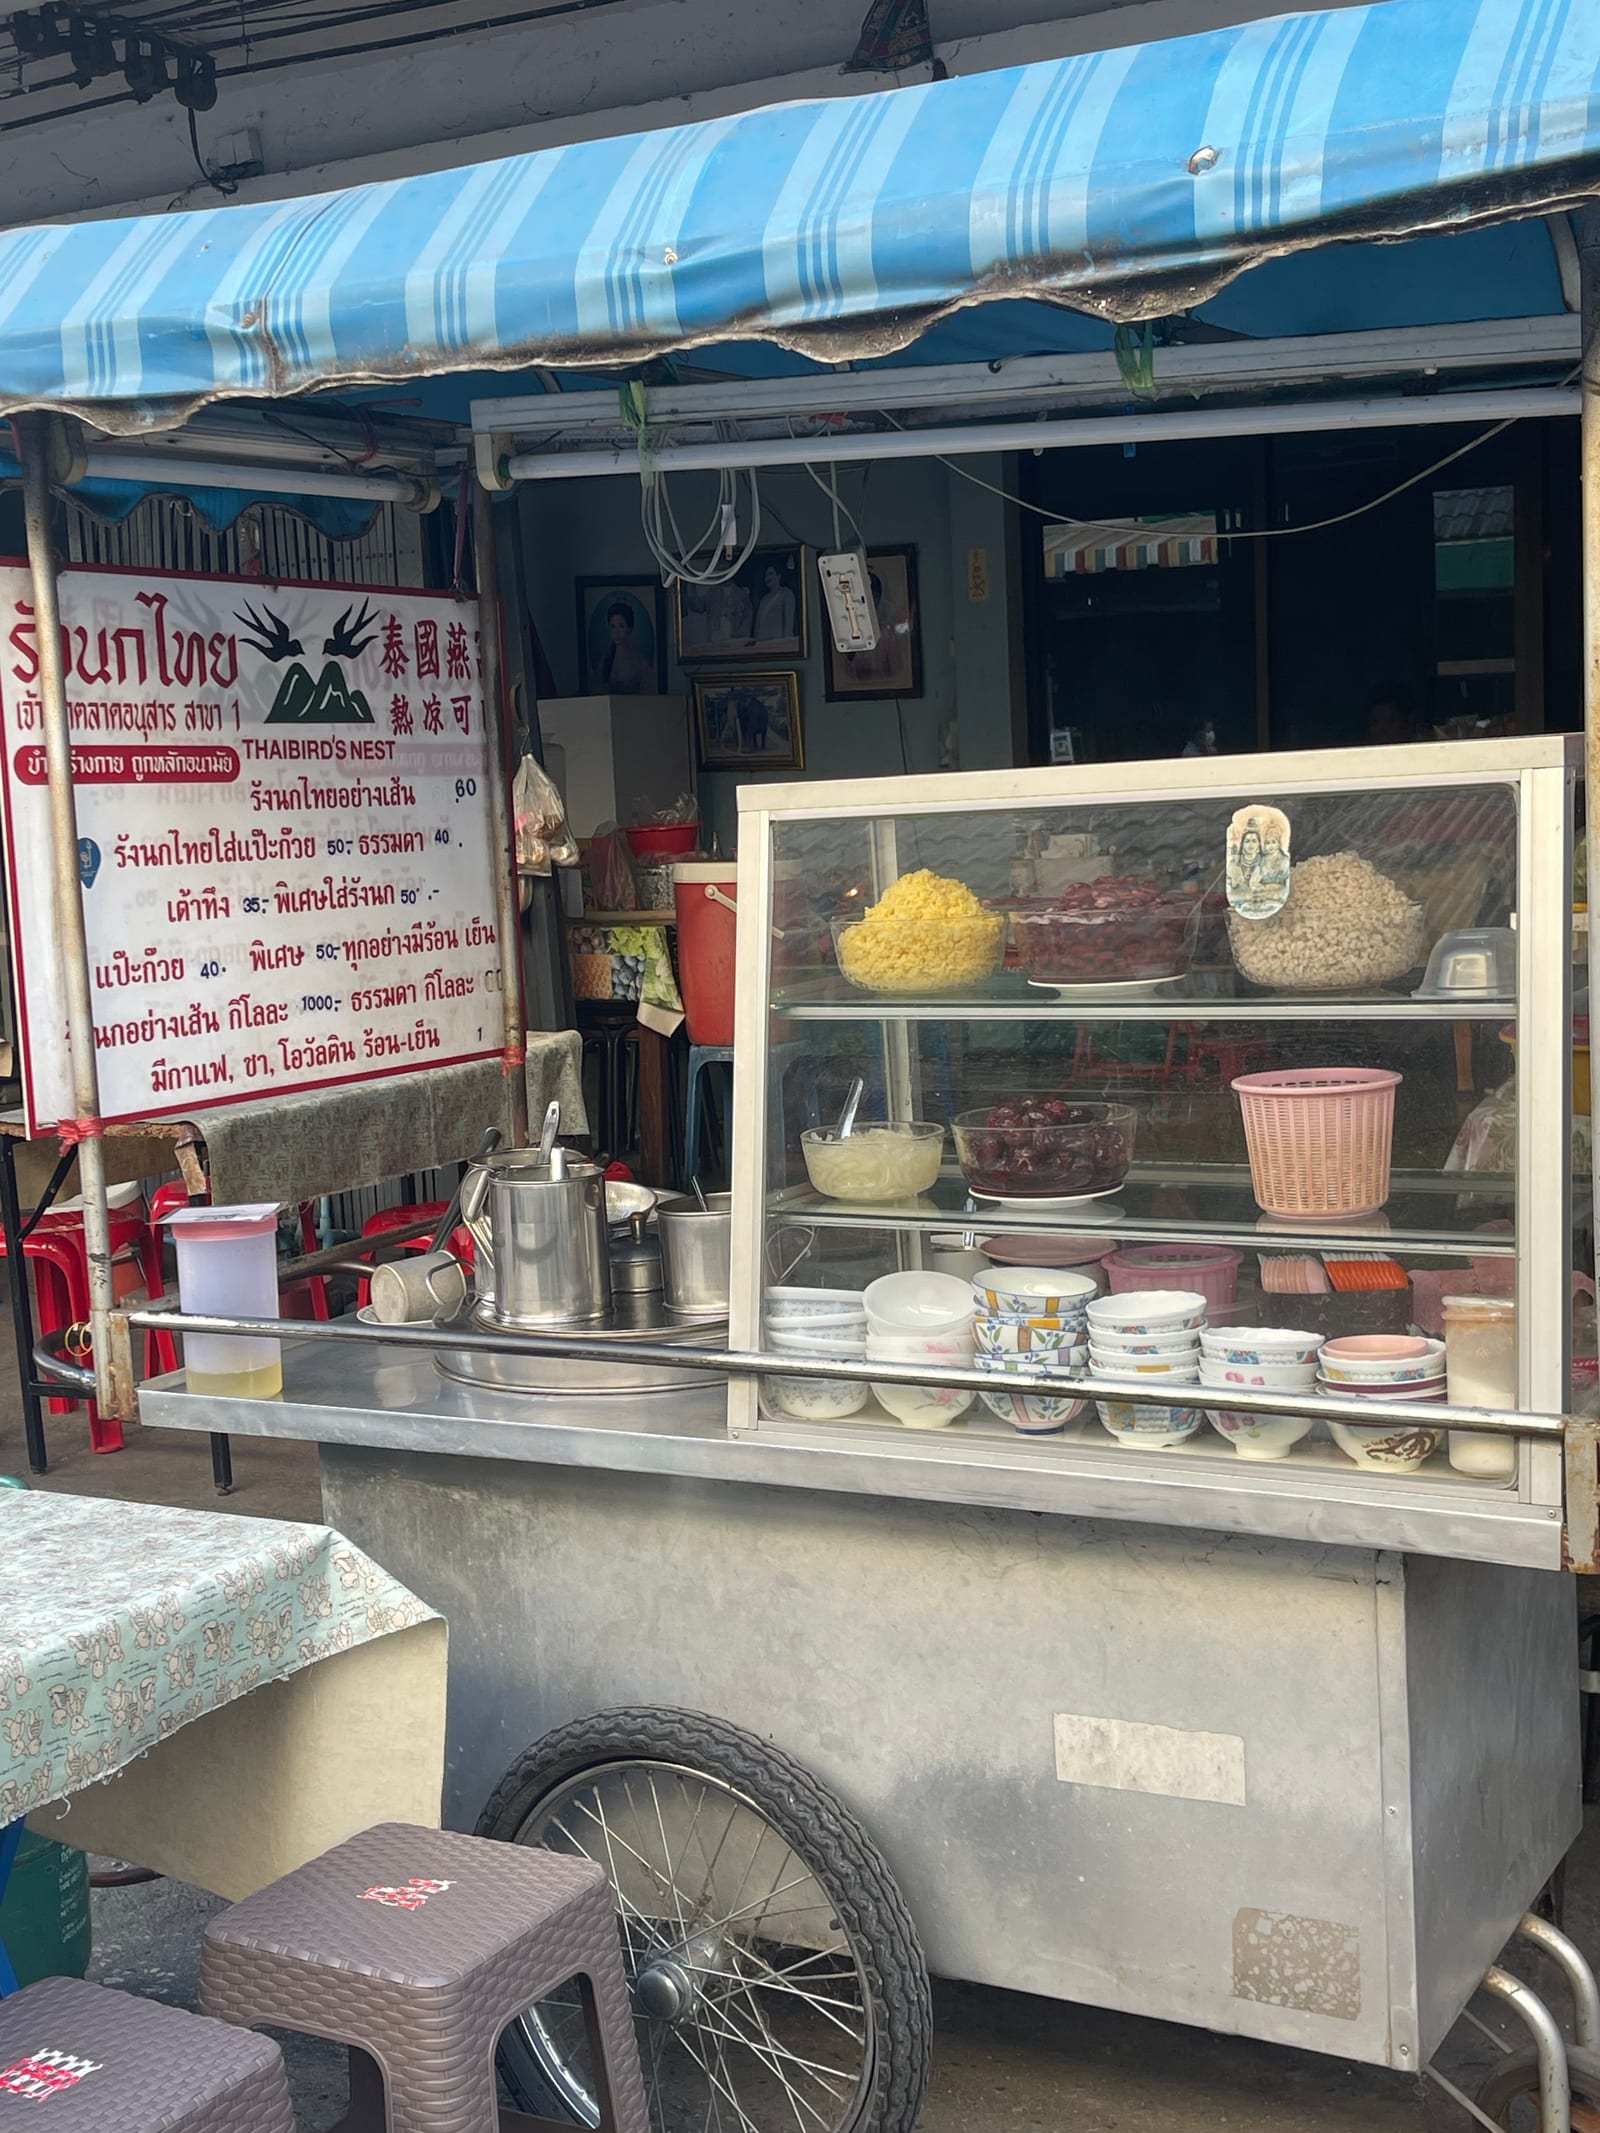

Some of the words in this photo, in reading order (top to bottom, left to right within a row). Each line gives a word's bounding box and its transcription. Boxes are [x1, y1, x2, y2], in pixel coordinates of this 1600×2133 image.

[379, 613, 483, 680] 泰國燕
[184, 699, 222, 731] สาขา
[231, 698, 241, 732] 1
[242, 734, 347, 761] THAIBIRD'S
[350, 740, 397, 760] NEST
[249, 776, 417, 811] รังนกไทยอย่างเส้น
[358, 831, 425, 856] ธรรมดา
[273, 876, 396, 914] พิเศษใส่รังนก
[249, 940, 306, 972] พิเศษ
[341, 920, 459, 971] ทุกอย่างมีร้อน
[464, 916, 496, 948] เย็น
[228, 993, 290, 1031] กิโลละ
[350, 984, 417, 1012] ธรรมดา
[424, 968, 475, 1002] กิโลละ
